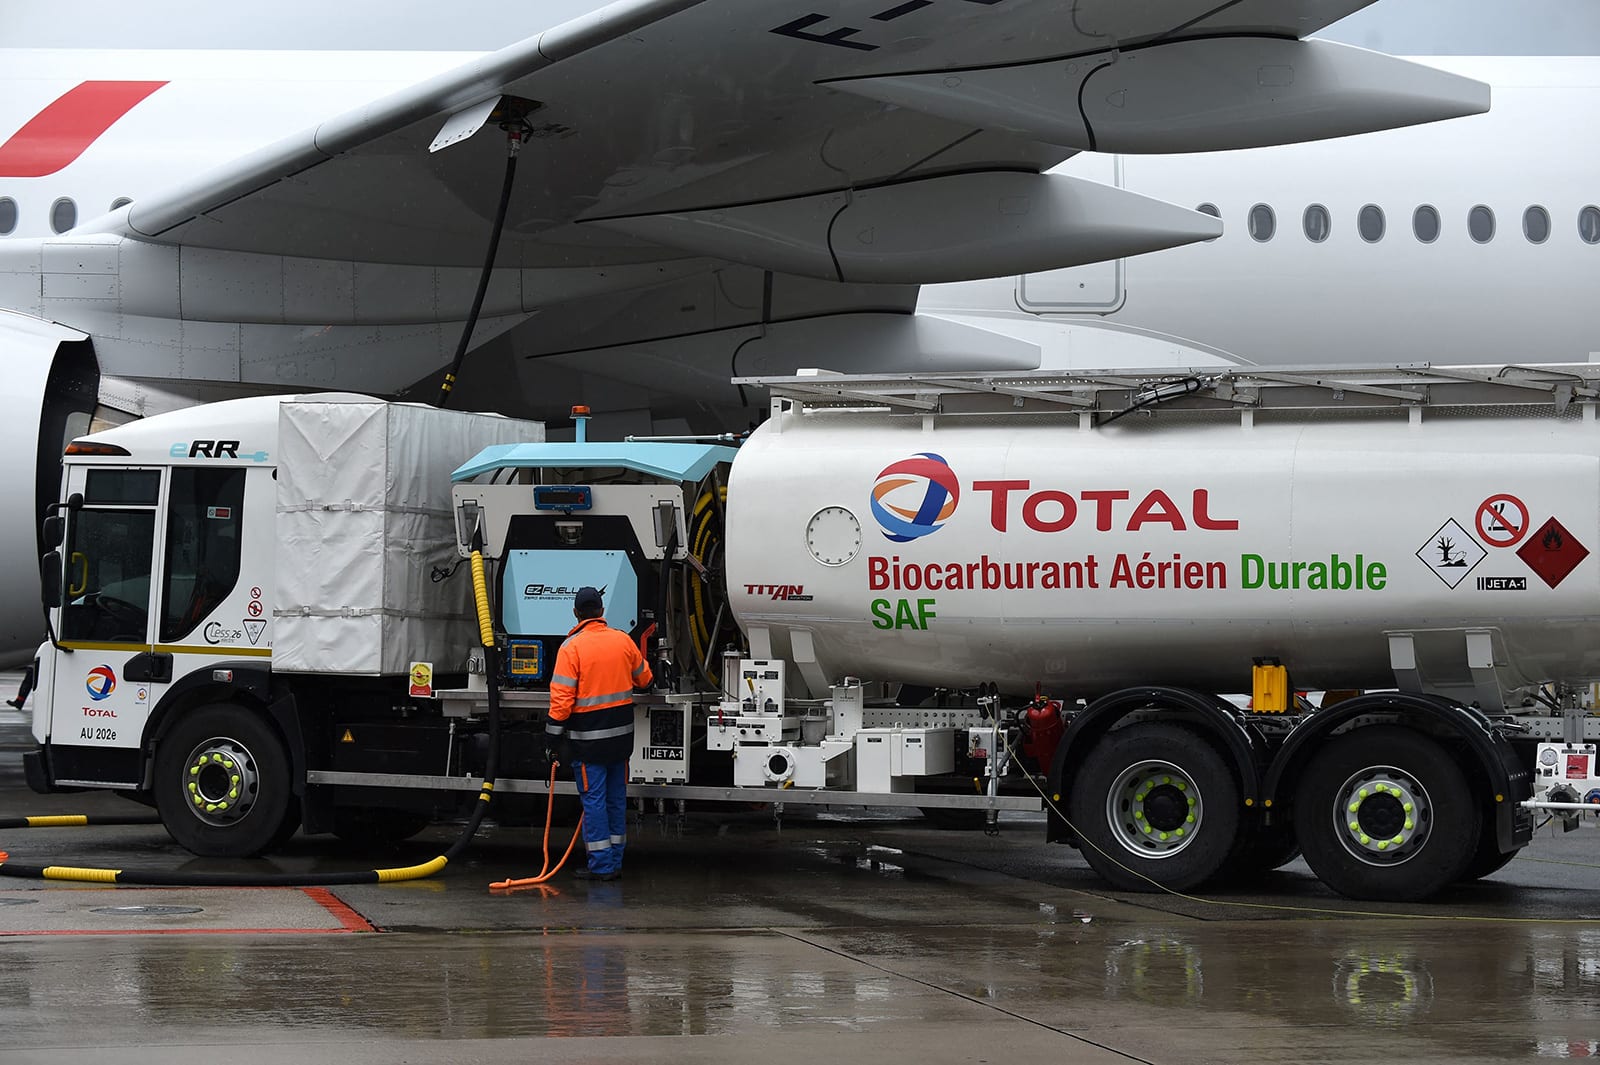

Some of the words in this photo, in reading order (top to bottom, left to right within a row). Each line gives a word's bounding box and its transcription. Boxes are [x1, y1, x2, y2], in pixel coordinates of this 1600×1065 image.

[169, 440, 240, 458] eRR
[972, 479, 1240, 533] TOTAL
[867, 554, 1099, 590] Biocarburant
[1109, 552, 1227, 589] Aérien
[1240, 553, 1388, 591] Durable
[1487, 579, 1508, 589] JET
[1508, 579, 1526, 589] A-1
[743, 584, 804, 601] TITAN
[870, 598, 937, 631] SAF
[231, 630, 242, 639] 26
[82, 706, 118, 718] TOTAL
[80, 727, 94, 740] AU
[96, 728, 117, 741] 202e
[651, 749, 668, 758] JET
[668, 749, 683, 759] A-1
